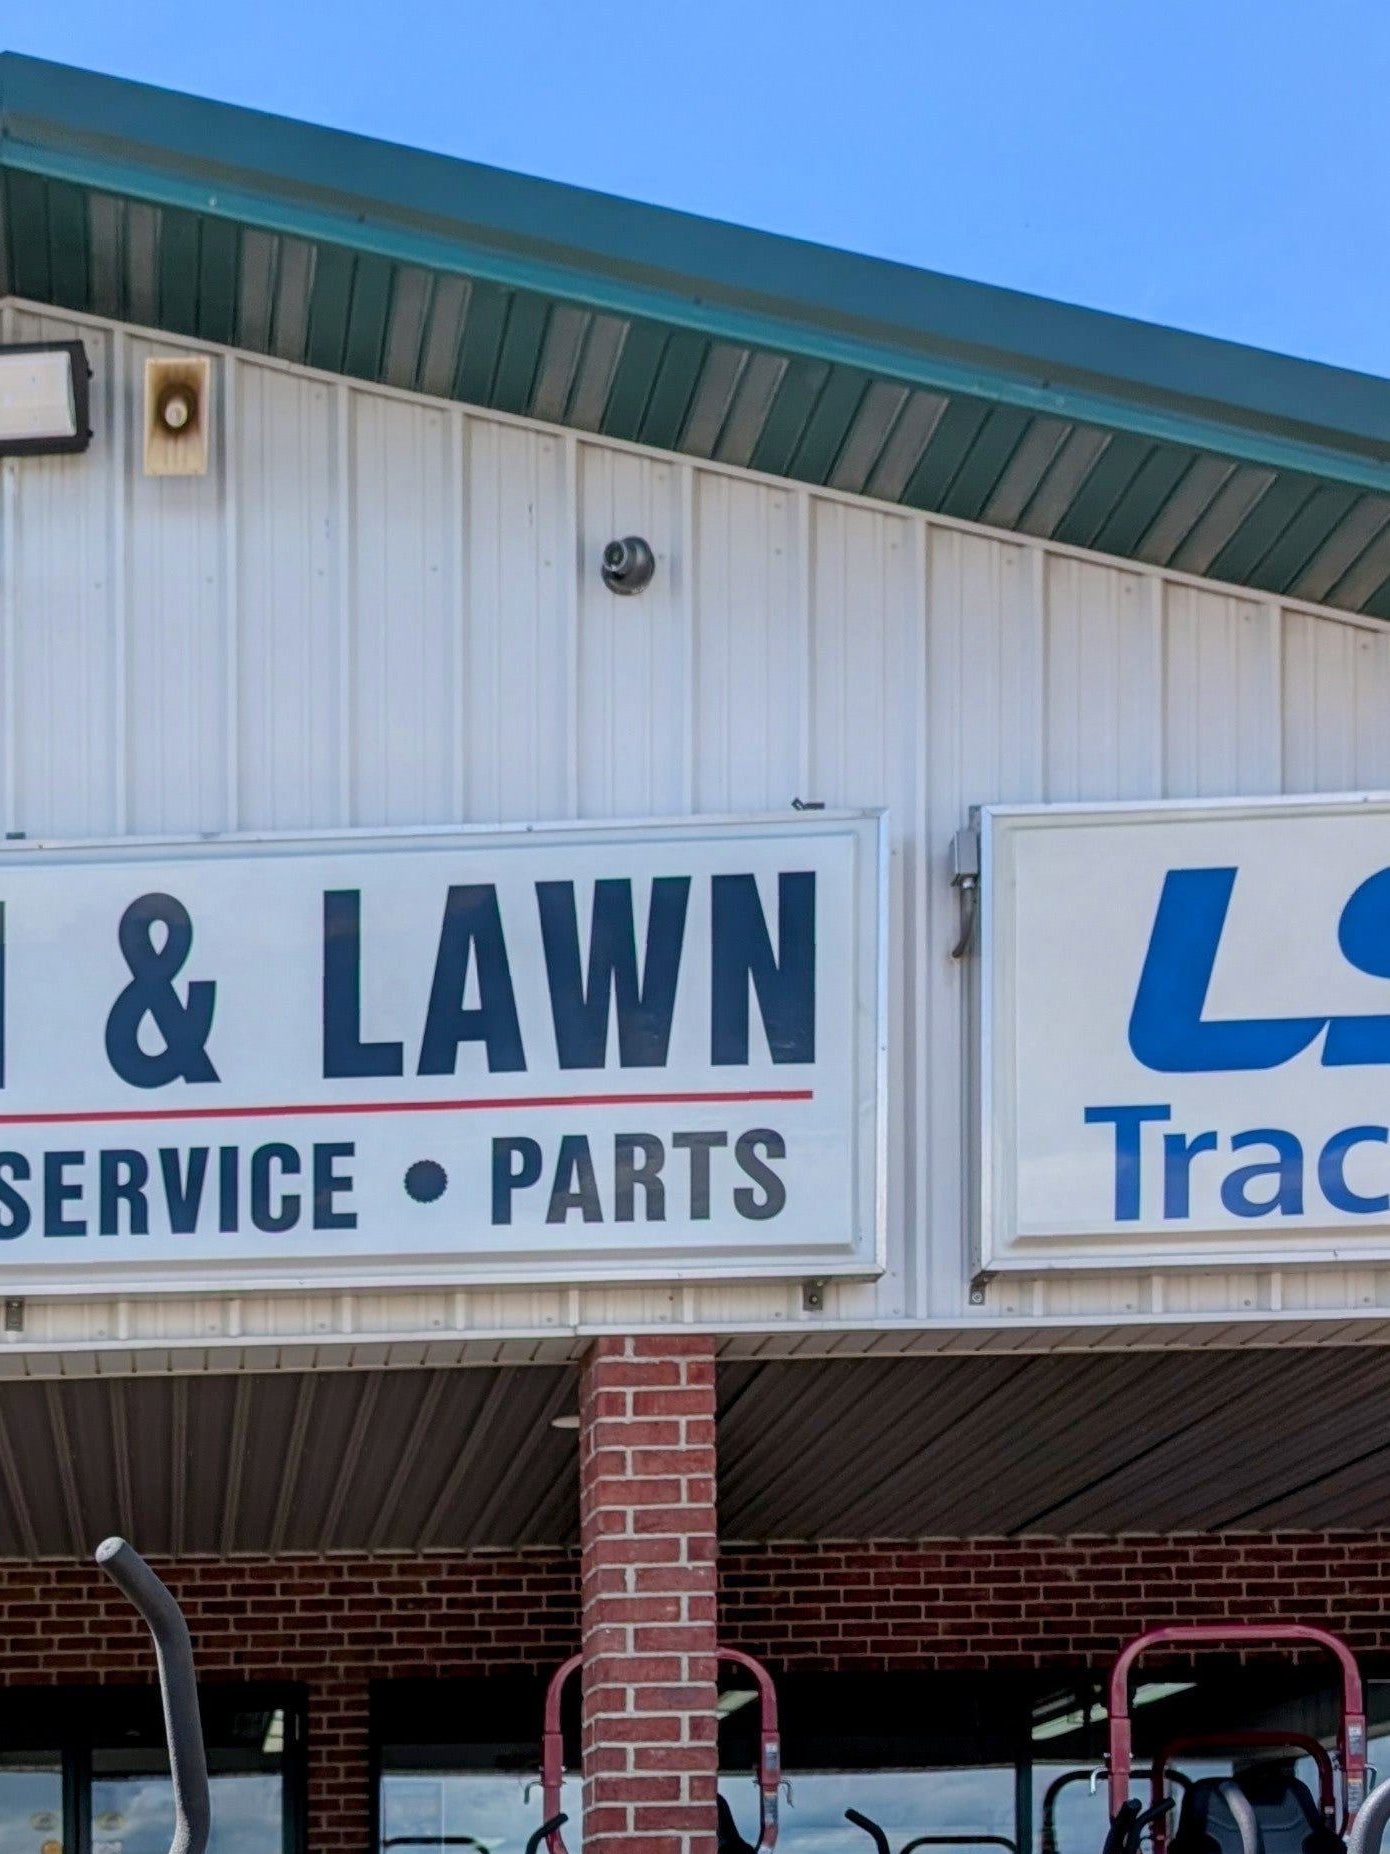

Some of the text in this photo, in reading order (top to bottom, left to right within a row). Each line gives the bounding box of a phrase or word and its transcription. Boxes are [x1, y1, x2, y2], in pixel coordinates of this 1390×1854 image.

[105, 892, 222, 1089] &
[322, 870, 817, 1078] LAWN
[490, 1128, 787, 1225] PARTS
[1084, 1103, 1390, 1222] Trac
